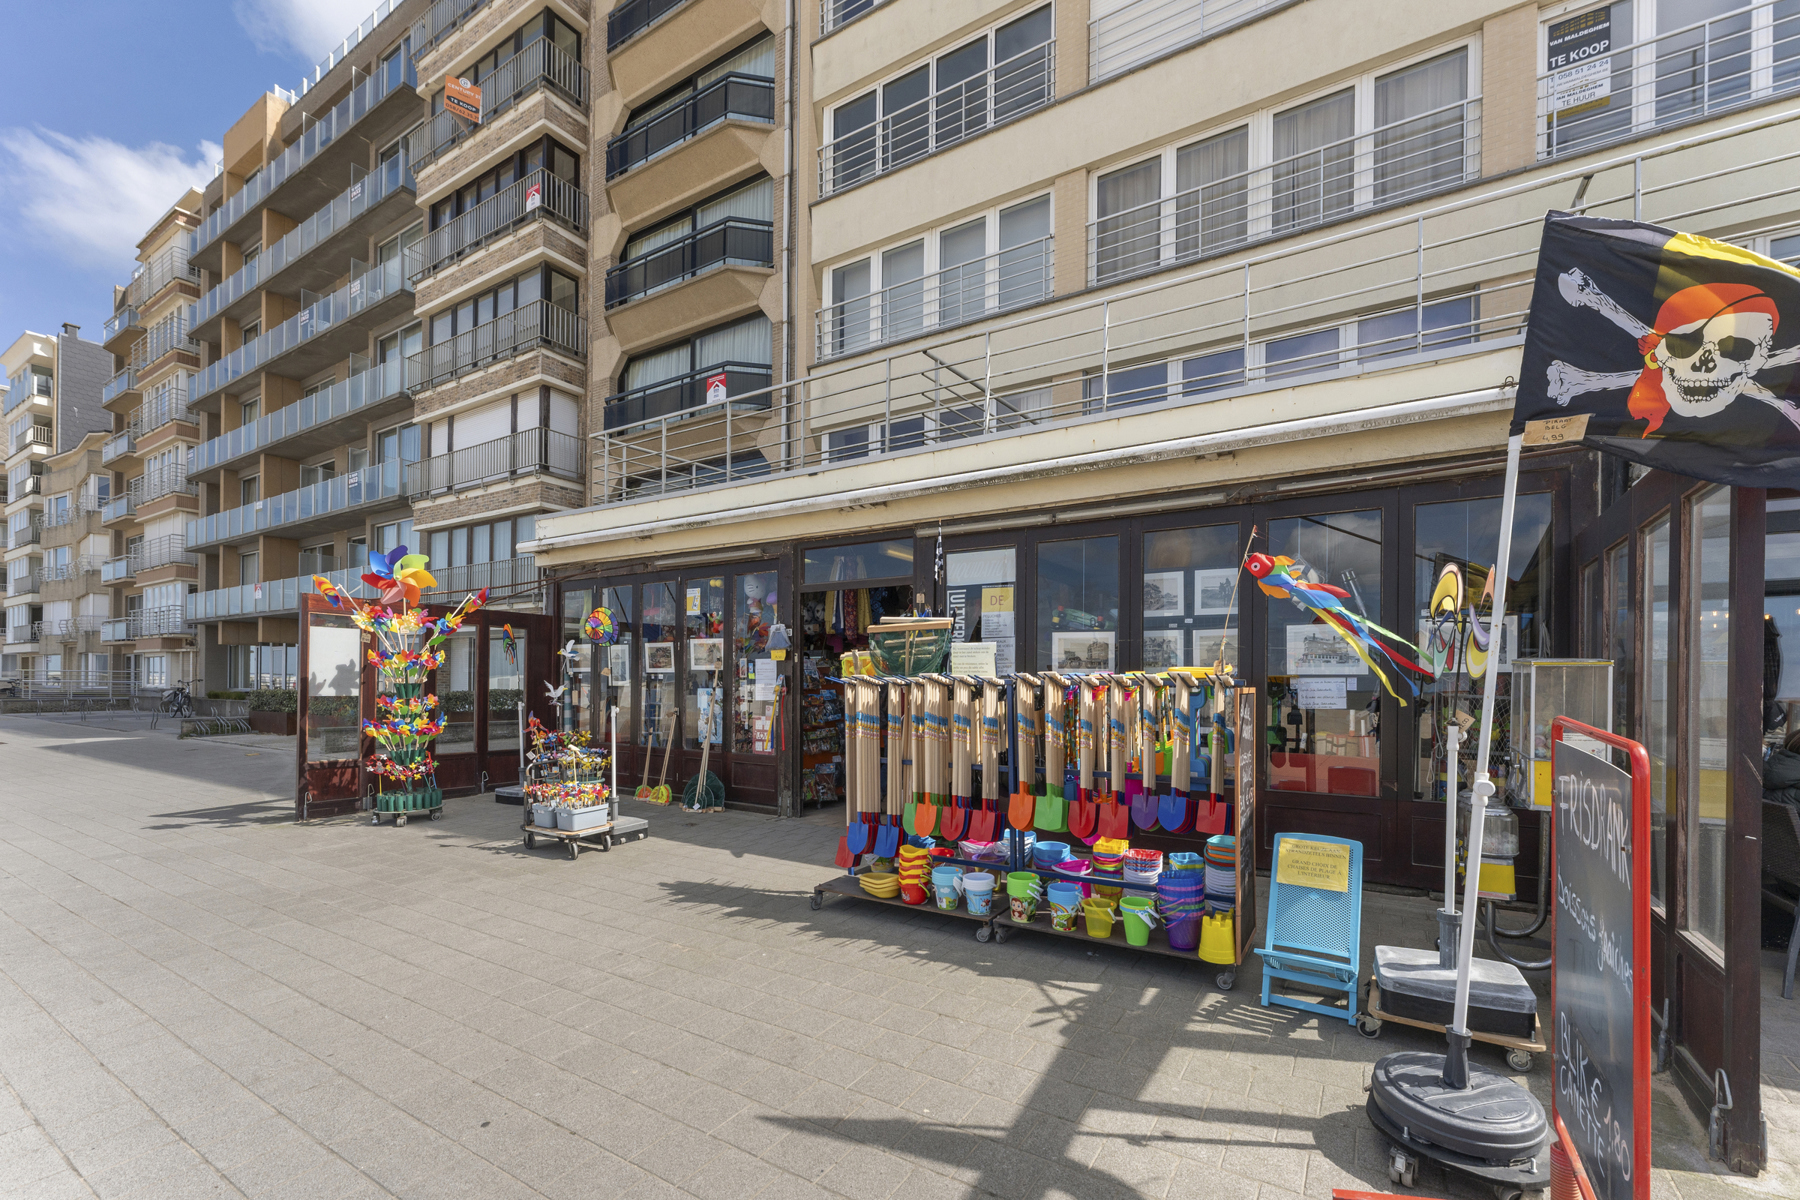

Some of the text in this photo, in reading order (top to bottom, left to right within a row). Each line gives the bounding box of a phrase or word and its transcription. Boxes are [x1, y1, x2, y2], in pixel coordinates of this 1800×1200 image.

[1549, 38, 1563, 46] VAN
[1564, 22, 1610, 42] MALDEGHEM
[1549, 53, 1566, 68] TE
[1570, 40, 1609, 62] KOOP
[1558, 71, 1573, 80] 058
[1575, 67, 1584, 75] 51
[1587, 63, 1597, 71] 24
[1599, 59, 1609, 67] 24
[447, 82, 475, 97] CENTURY
[1567, 83, 1604, 98] MALDEGHEM
[459, 101, 477, 112] KOOP
[1562, 91, 1596, 107] TE HUUR
[990, 595, 1004, 606] DE
[1326, 852, 1347, 860] BINNEN
[1560, 1011, 1590, 1109] BLIK
[1560, 1065, 1605, 1178] CANETTE
